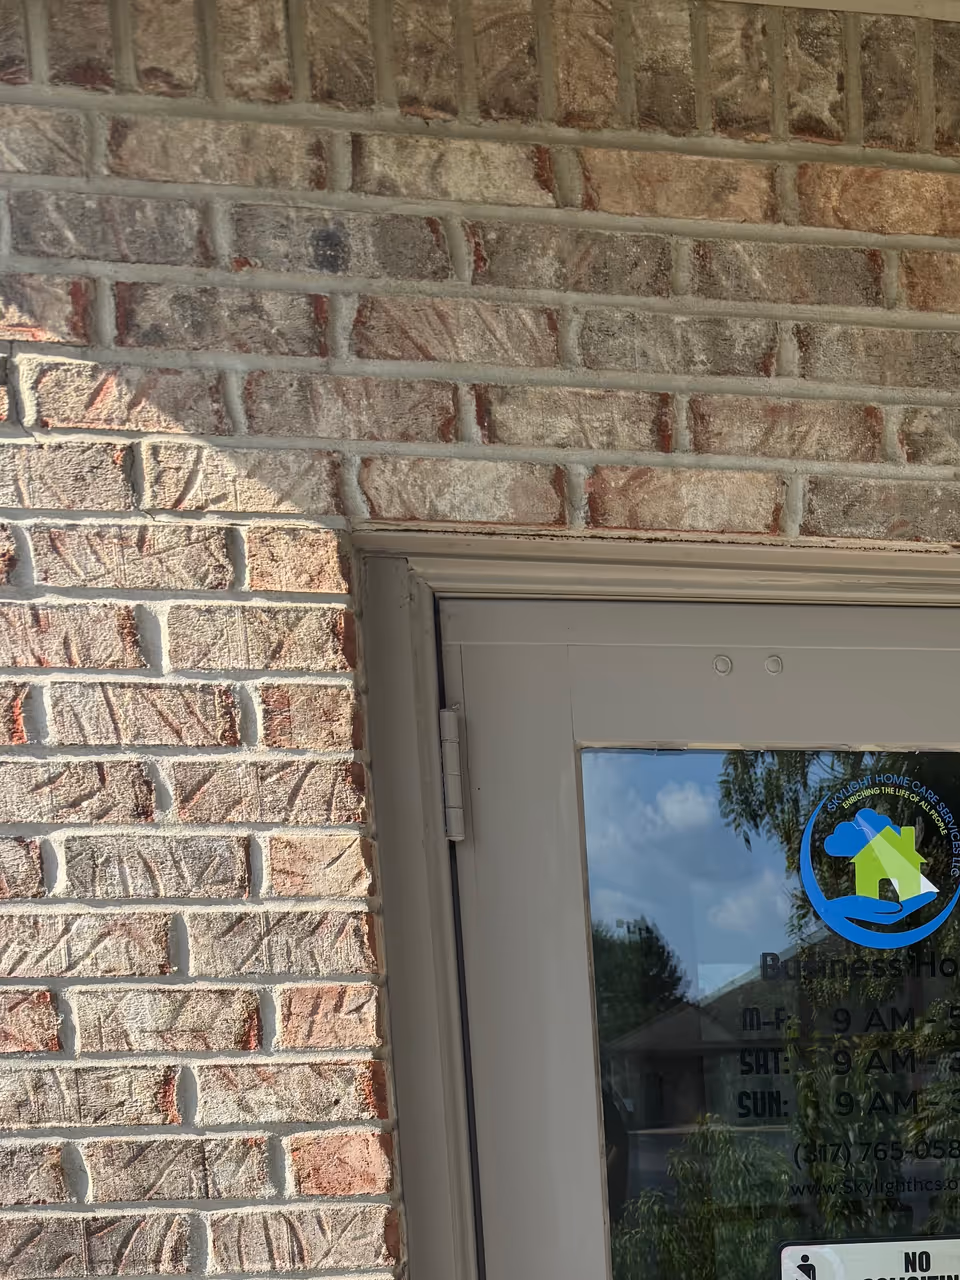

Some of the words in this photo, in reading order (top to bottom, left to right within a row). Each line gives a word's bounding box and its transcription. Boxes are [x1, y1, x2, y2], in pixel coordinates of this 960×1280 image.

[827, 775, 872, 812] SKYLIGHT
[875, 773, 910, 788] HOME
[911, 781, 940, 805] CARE
[842, 787, 880, 809] ENRICHING
[881, 786, 895, 795] THE
[896, 788, 909, 798] LIFE
[909, 793, 920, 802] OF
[919, 800, 930, 812] ALL
[929, 809, 948, 836] PEOPLE
[761, 952, 902, 980] Business
[742, 1007, 792, 1031] M-F:
[832, 1008, 850, 1034] 9
[863, 1007, 915, 1033] AM
[740, 1048, 790, 1075] SAT:
[833, 1050, 851, 1076] 9
[865, 1049, 916, 1073] AM
[738, 1091, 789, 1118] SUN:
[836, 1091, 855, 1116] 9
[867, 1091, 919, 1115] AM
[793, 1142, 851, 1170] (317)
[904, 1251, 931, 1273] NO
